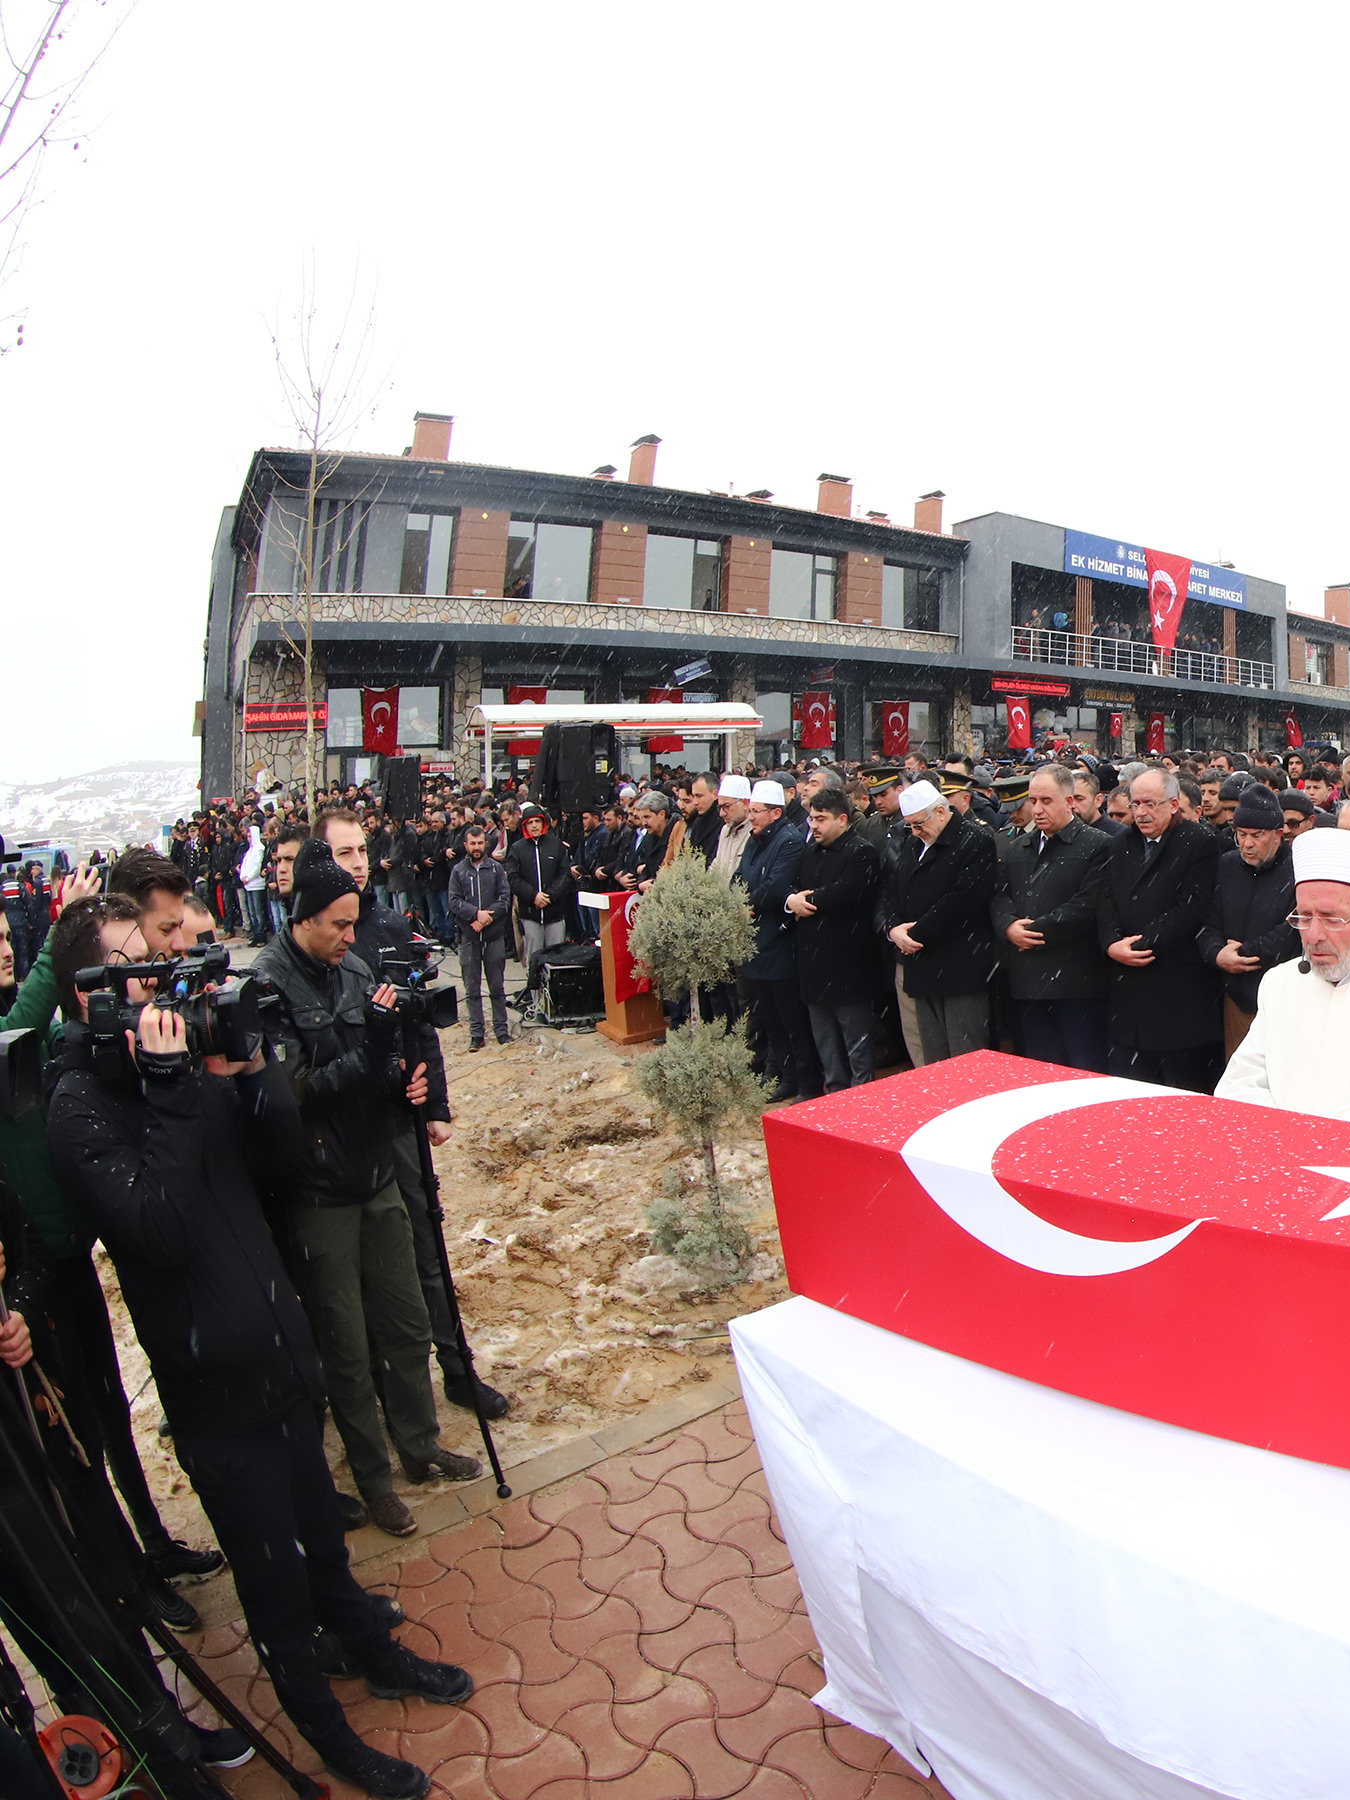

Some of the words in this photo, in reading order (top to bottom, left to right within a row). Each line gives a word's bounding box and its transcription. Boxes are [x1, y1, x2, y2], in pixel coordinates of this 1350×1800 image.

[1071, 554, 1086, 568] EK
[1087, 556, 1125, 576] HİZMET
[1208, 585, 1243, 603] MERKEZİ
[269, 712, 288, 721] GIDA
[288, 711, 317, 721] MART
